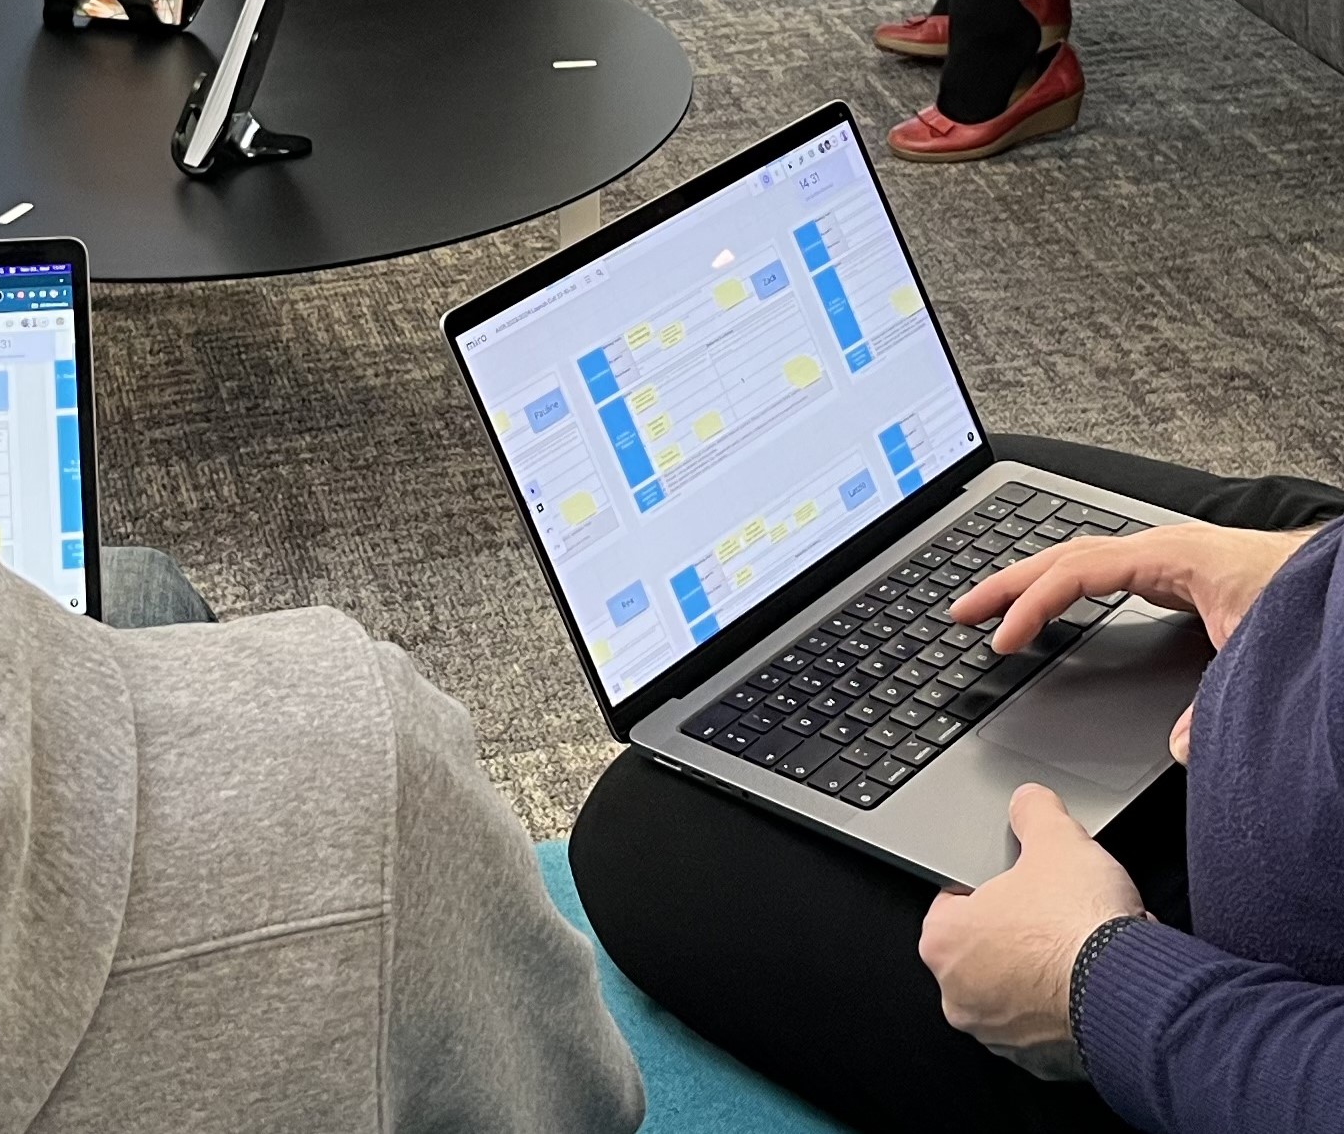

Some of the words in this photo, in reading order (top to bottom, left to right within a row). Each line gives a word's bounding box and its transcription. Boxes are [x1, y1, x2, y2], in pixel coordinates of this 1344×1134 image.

[761, 271, 777, 286] Zack
[0, 339, 12, 350] 31
[464, 331, 488, 352] miro
[532, 398, 560, 421] Pauline
